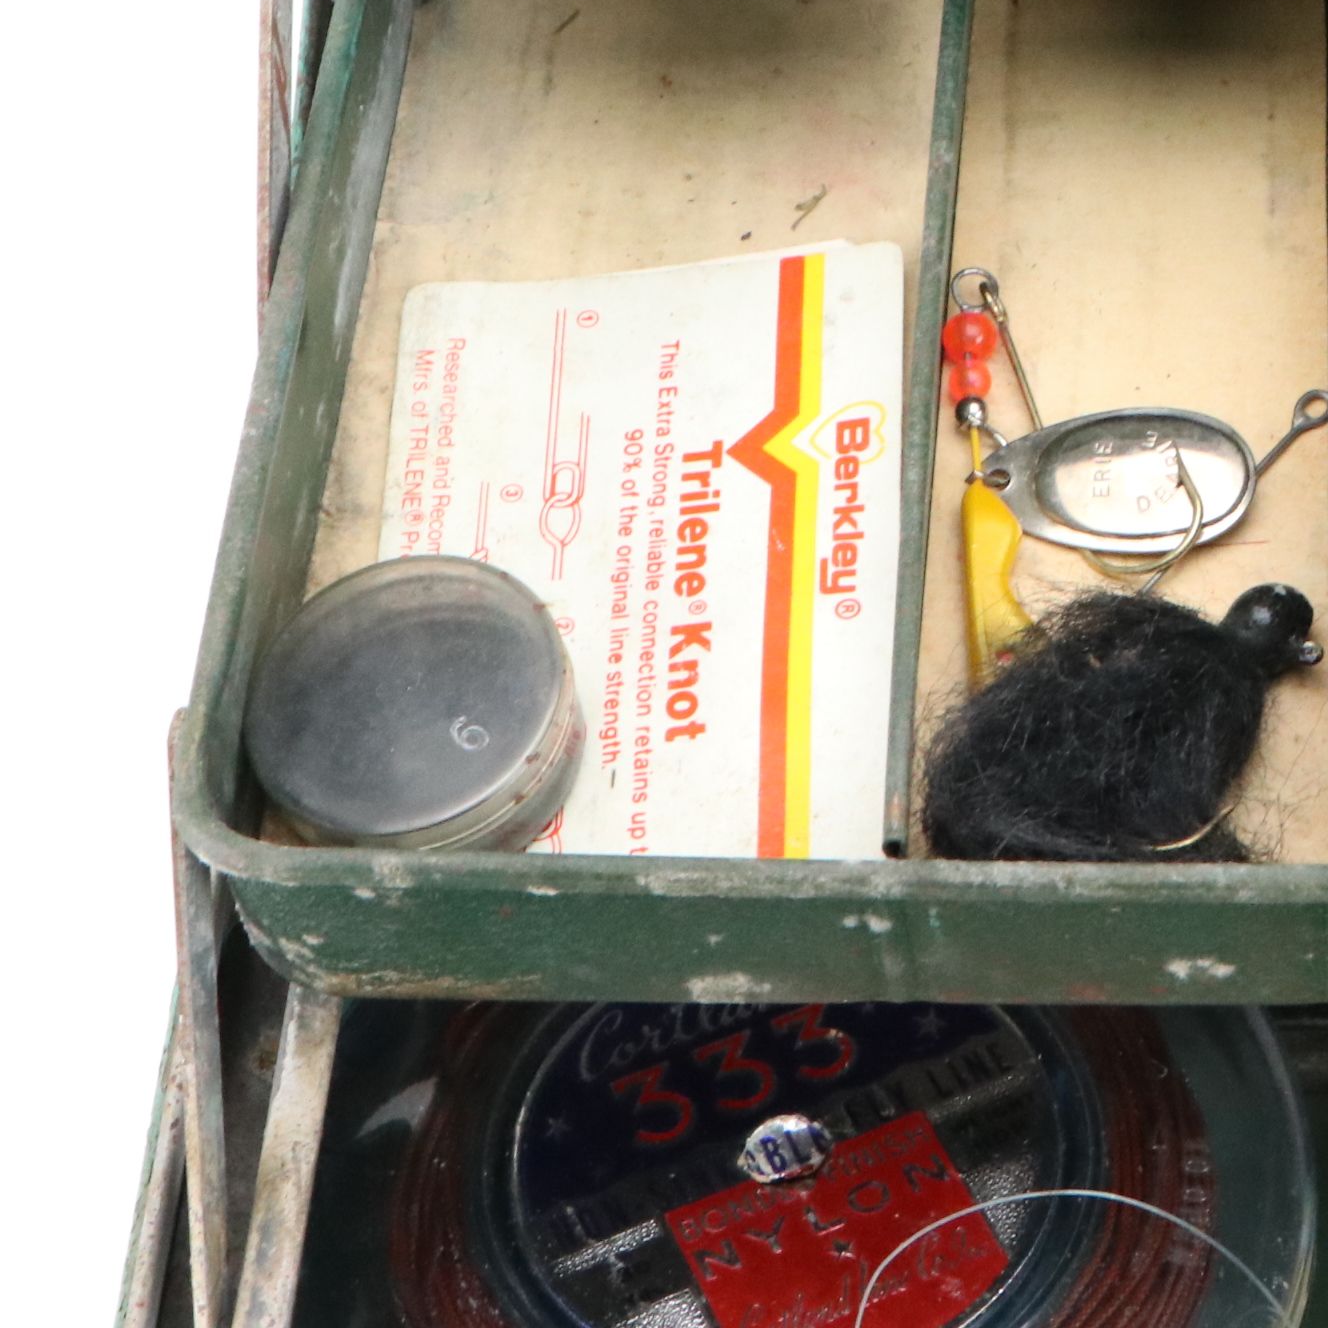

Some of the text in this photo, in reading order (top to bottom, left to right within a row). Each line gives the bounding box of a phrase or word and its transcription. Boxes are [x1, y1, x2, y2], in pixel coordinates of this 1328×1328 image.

[658, 340, 680, 381] This
[410, 401, 430, 418] of
[655, 386, 678, 438] Extra
[426, 338, 467, 556] Researched and Recom
[622, 429, 643, 473] 90%
[1093, 441, 1115, 500] ERIE
[620, 480, 640, 498] of
[646, 443, 676, 516] Strong,
[617, 506, 637, 538] the
[819, 417, 872, 620] Berkley®
[609, 545, 635, 620] original
[644, 519, 666, 592] reliable
[665, 440, 724, 743] Trilene® Knot
[607, 627, 630, 665] line
[635, 600, 659, 716] connection
[631, 725, 653, 803] retains
[626, 812, 649, 842] up
[929, 1041, 1017, 1097] LINE
[693, 1154, 951, 1281] NYLON
